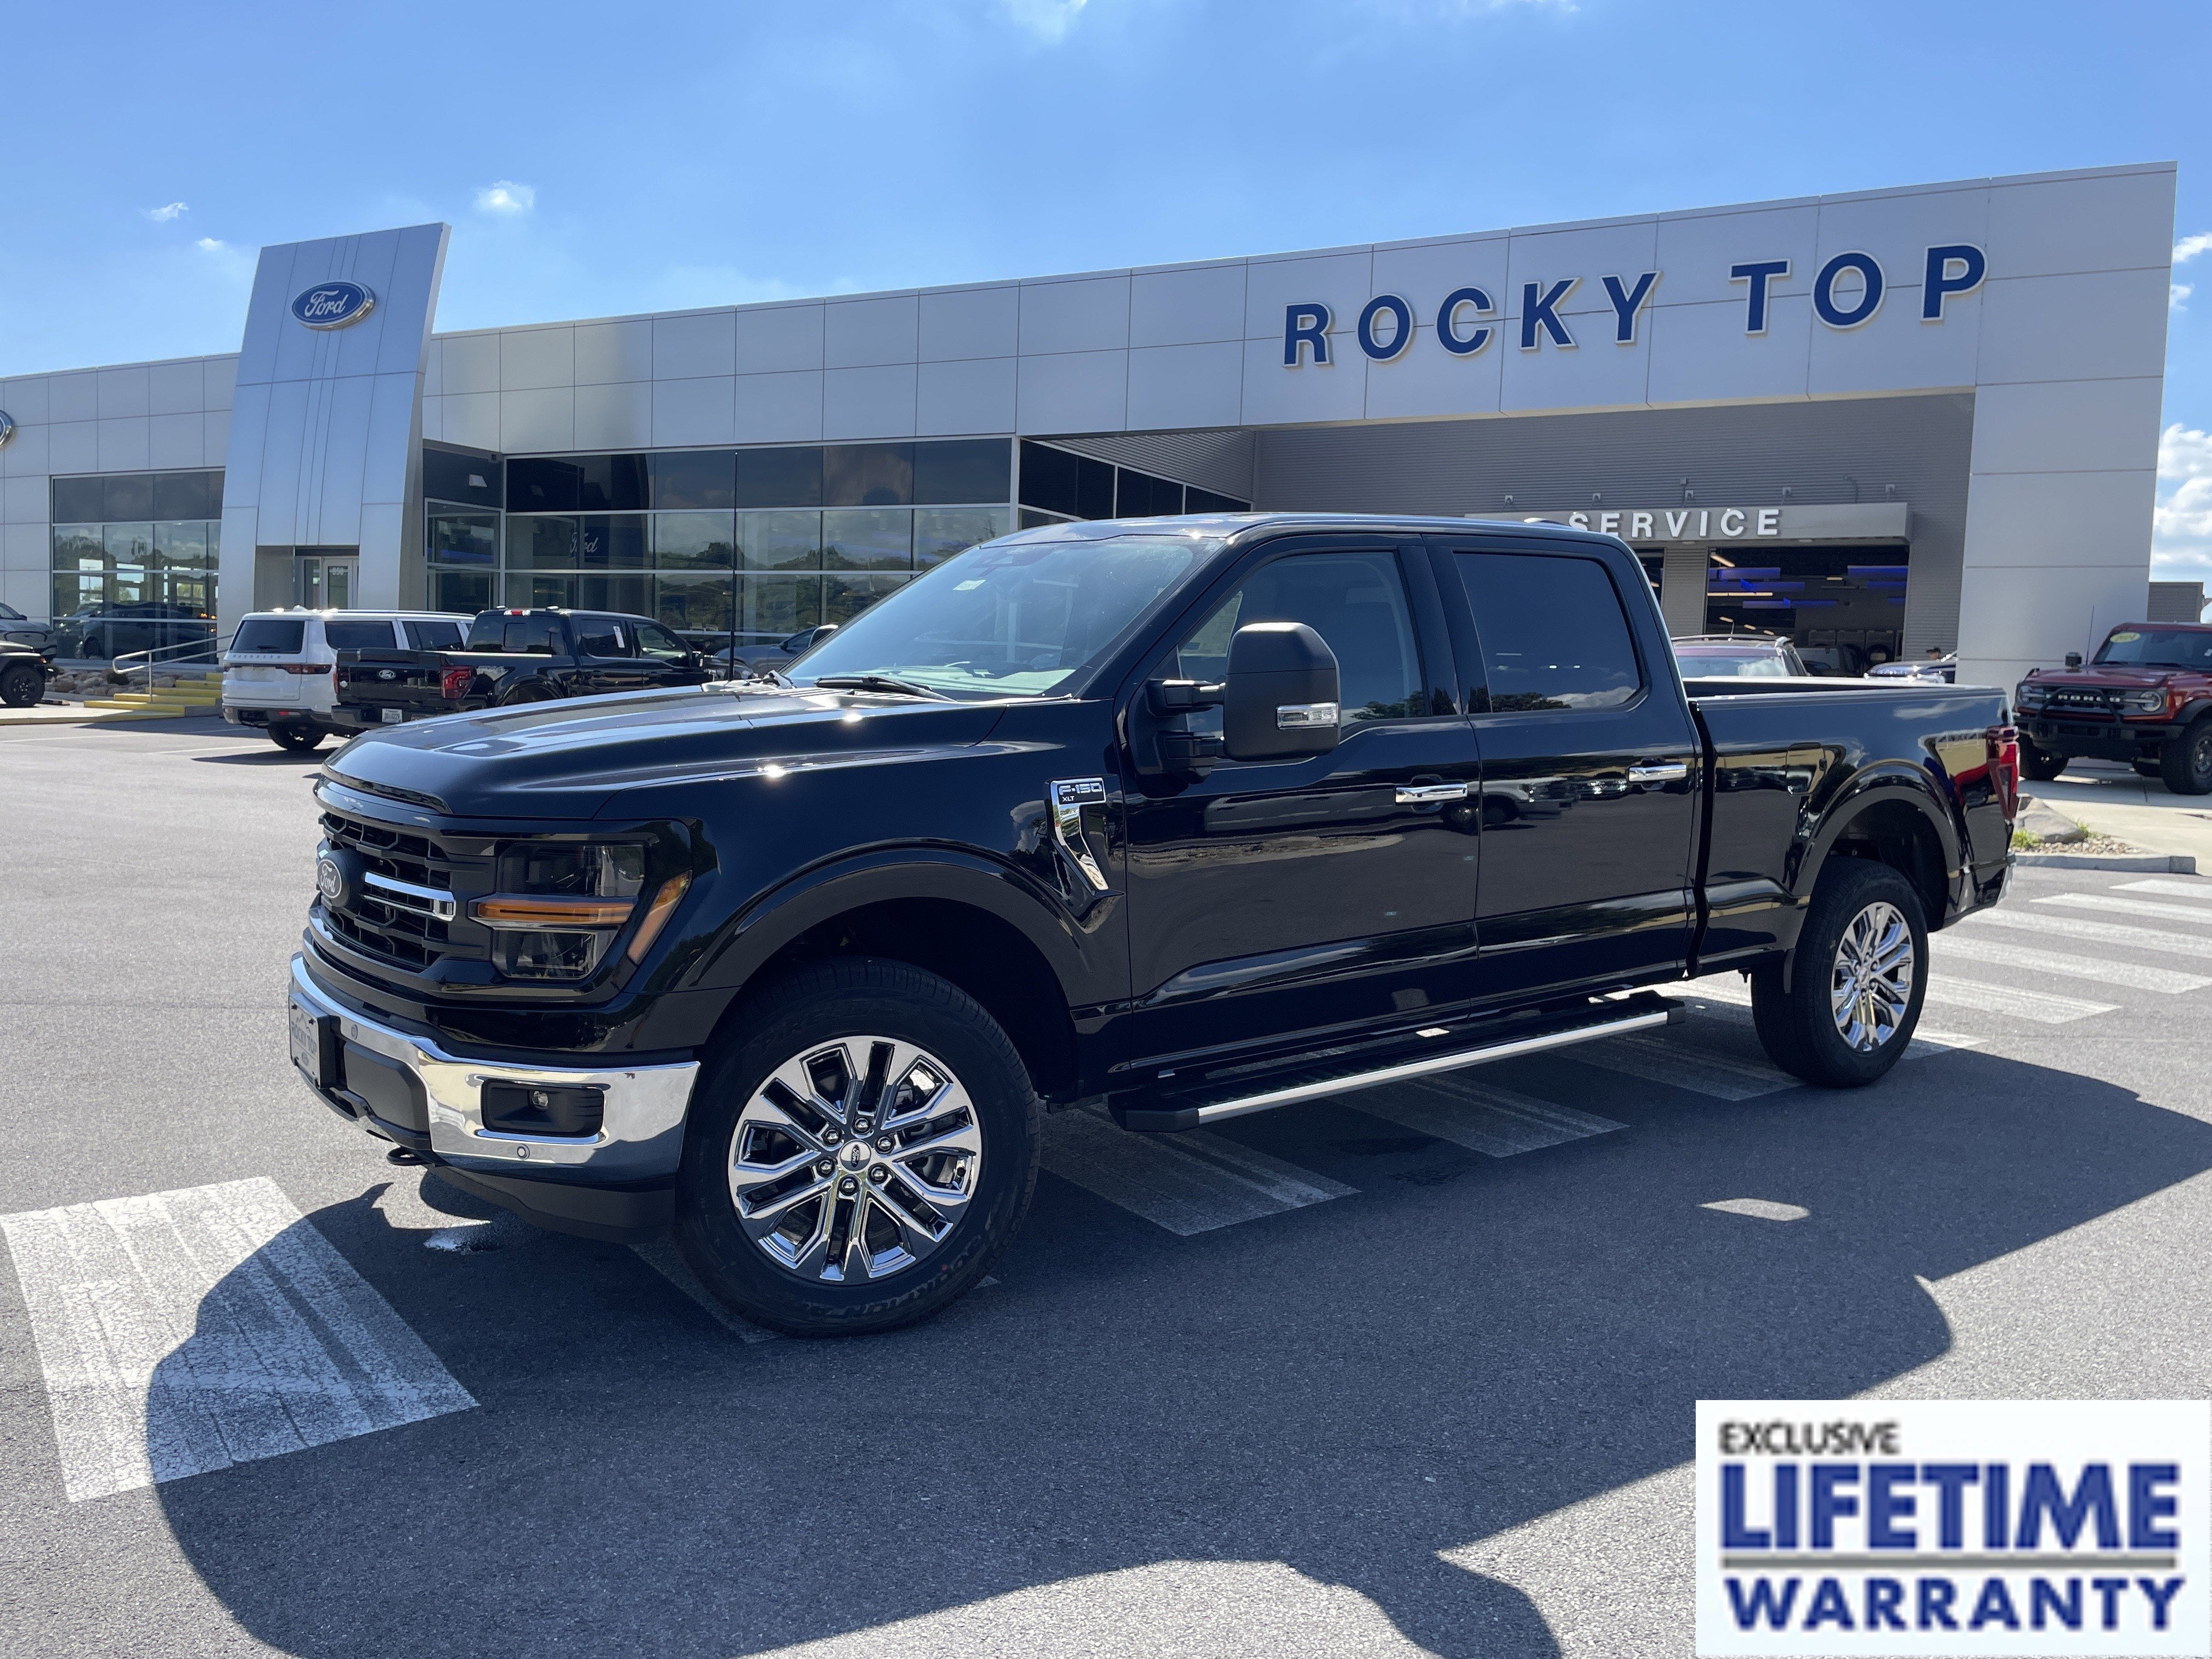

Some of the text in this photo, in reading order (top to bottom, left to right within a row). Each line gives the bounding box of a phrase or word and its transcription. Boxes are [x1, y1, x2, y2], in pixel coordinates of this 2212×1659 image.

[304, 290, 349, 317] Ford
[1282, 244, 1988, 368] ROCKY TOP
[1568, 508, 1779, 538] SERVICE
[1058, 782, 1103, 795] F-150
[320, 863, 336, 893] Ford
